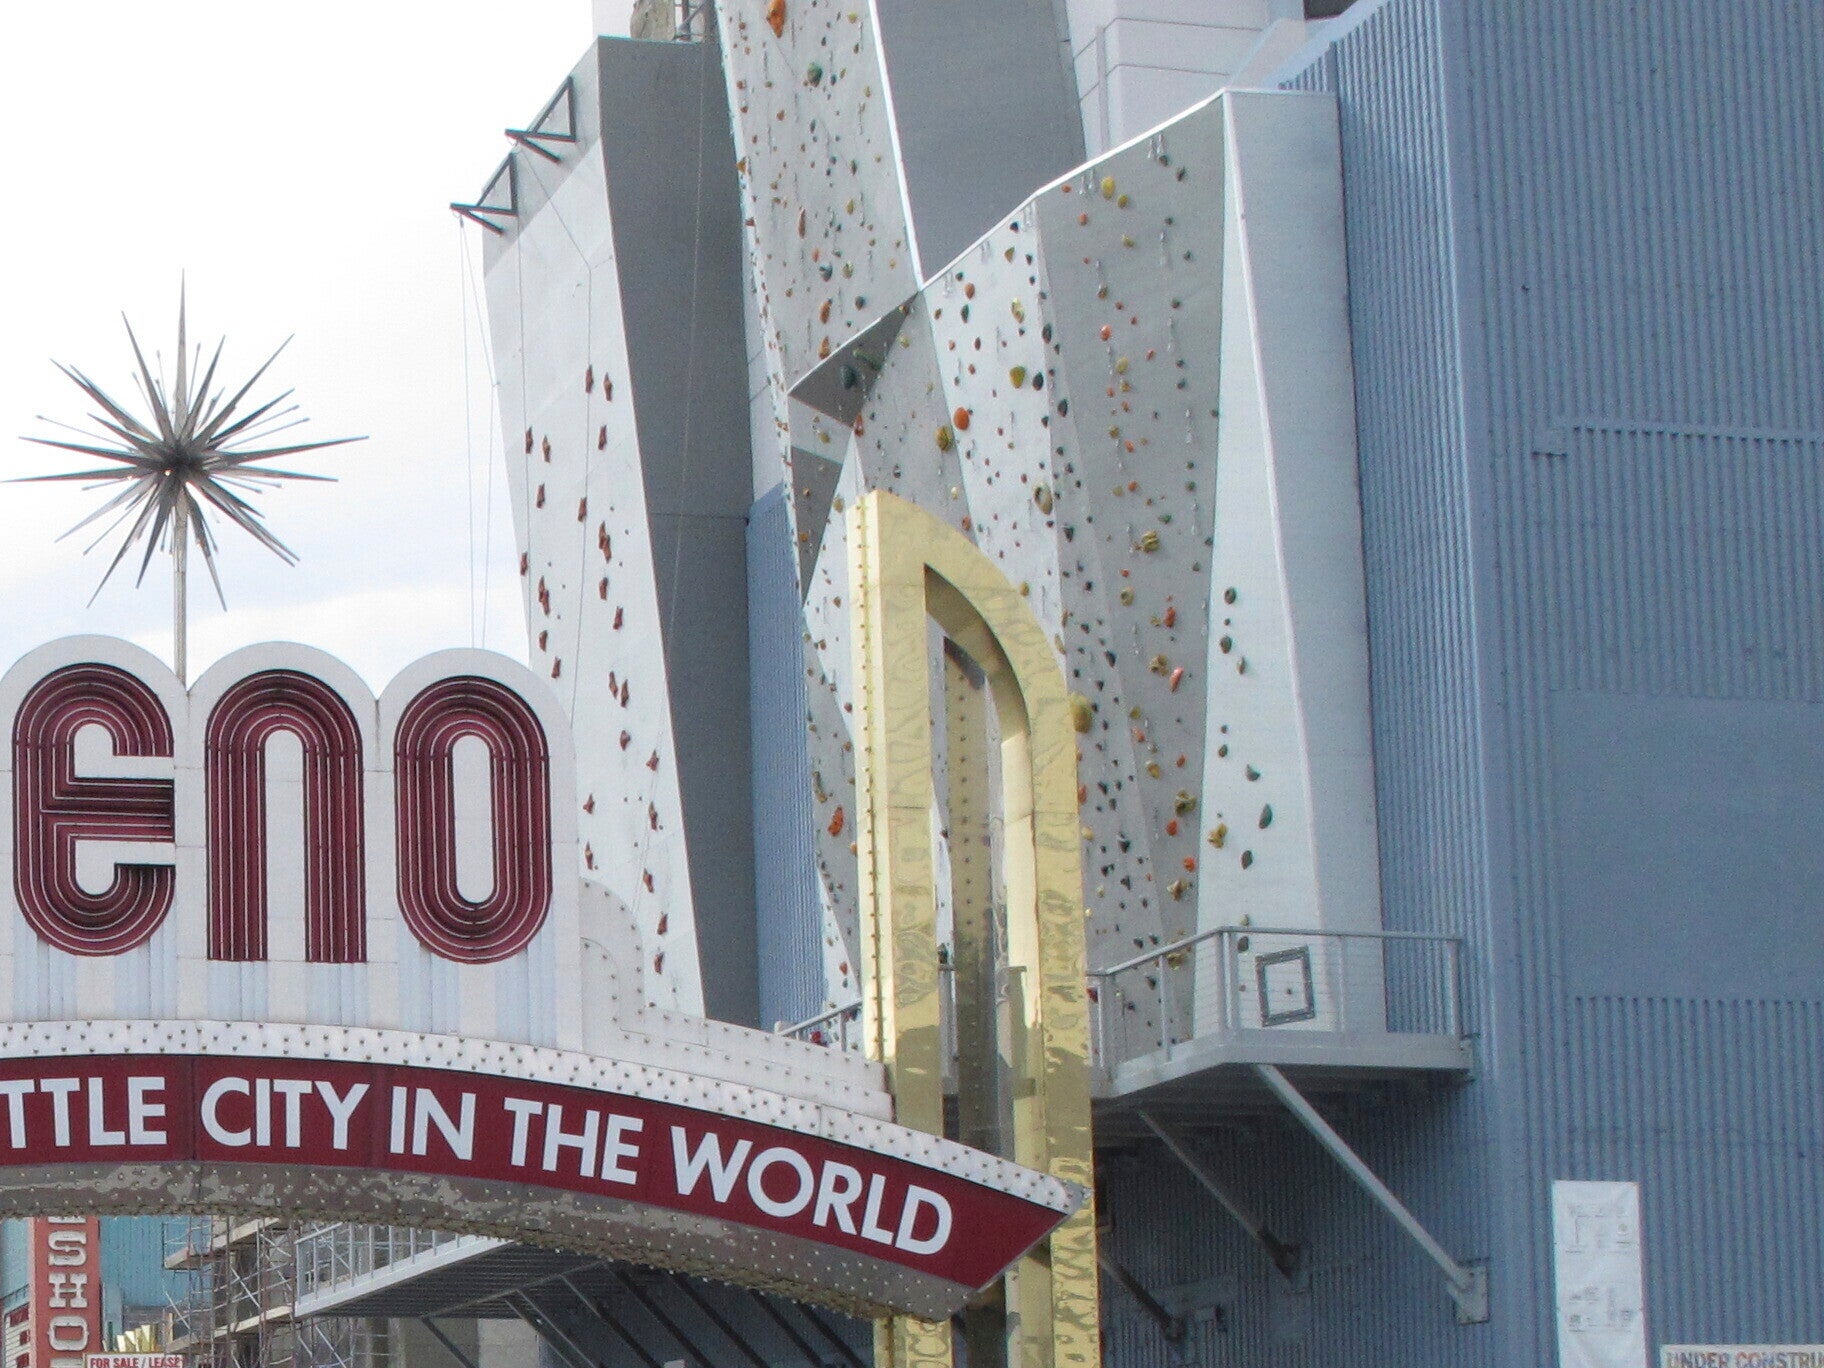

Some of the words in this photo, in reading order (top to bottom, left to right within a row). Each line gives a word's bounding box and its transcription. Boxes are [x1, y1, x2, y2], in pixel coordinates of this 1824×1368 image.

[201, 1077, 370, 1151] CITY
[389, 1087, 476, 1160] IN
[504, 1097, 643, 1184] THE
[670, 1125, 953, 1255] WORLD
[90, 1358, 110, 1368] FOR
[113, 1358, 139, 1368] SALE
[149, 1357, 180, 1368] LEASE
